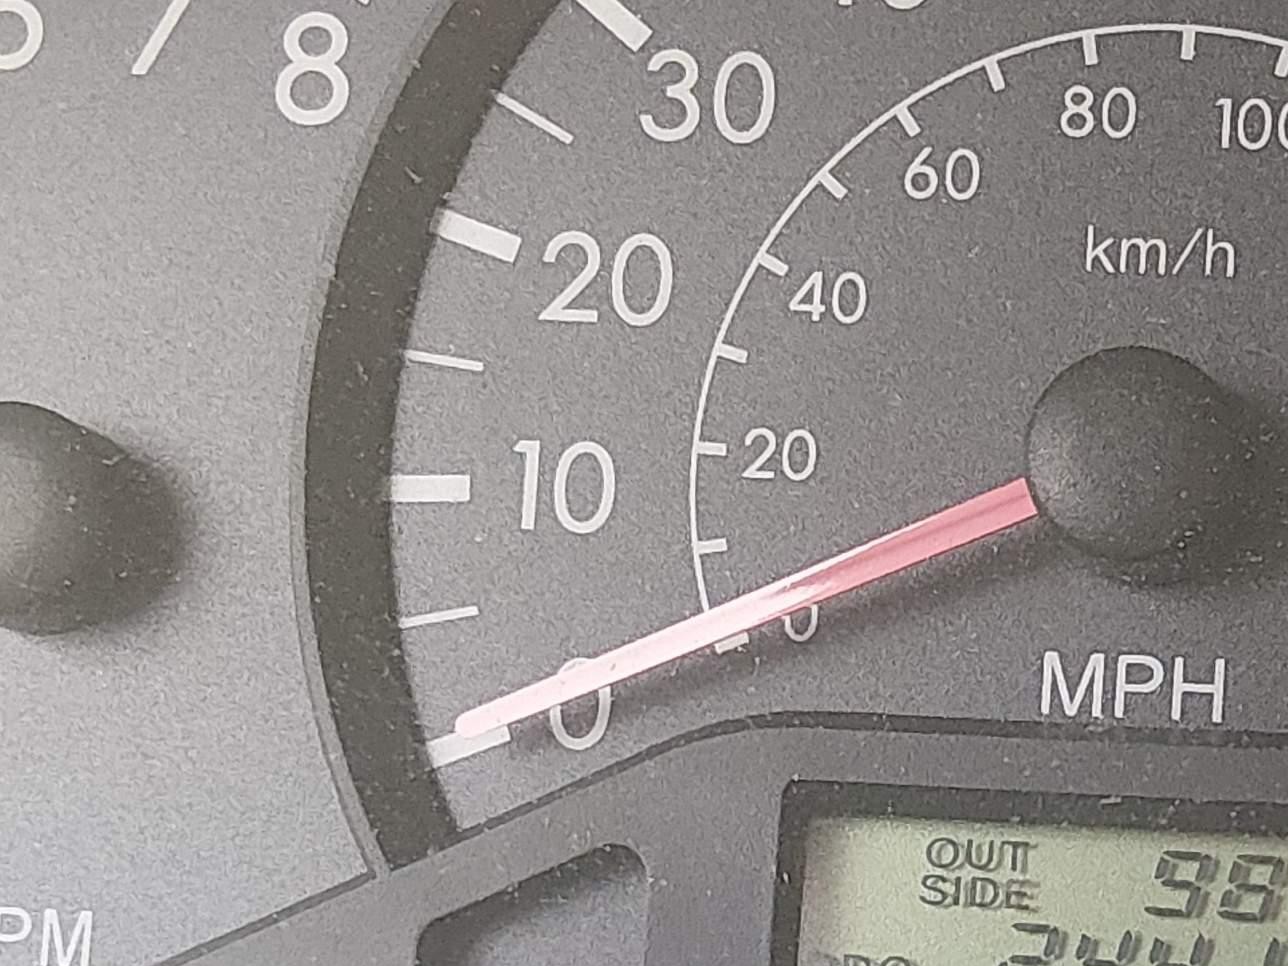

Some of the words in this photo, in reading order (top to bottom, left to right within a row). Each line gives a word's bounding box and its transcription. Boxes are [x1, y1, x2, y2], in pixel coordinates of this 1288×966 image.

[275, 11, 350, 126] 8
[639, 49, 776, 144] 30
[1059, 85, 1137, 139] 80
[903, 147, 981, 201] 60
[537, 230, 673, 327] 20
[1085, 225, 1236, 278] km/h
[788, 272, 867, 324] 40
[741, 427, 818, 482] 20
[512, 438, 616, 534] 10
[1040, 651, 1226, 724] MPH
[925, 836, 1037, 873] OUT
[918, 873, 1040, 913] SIDE
